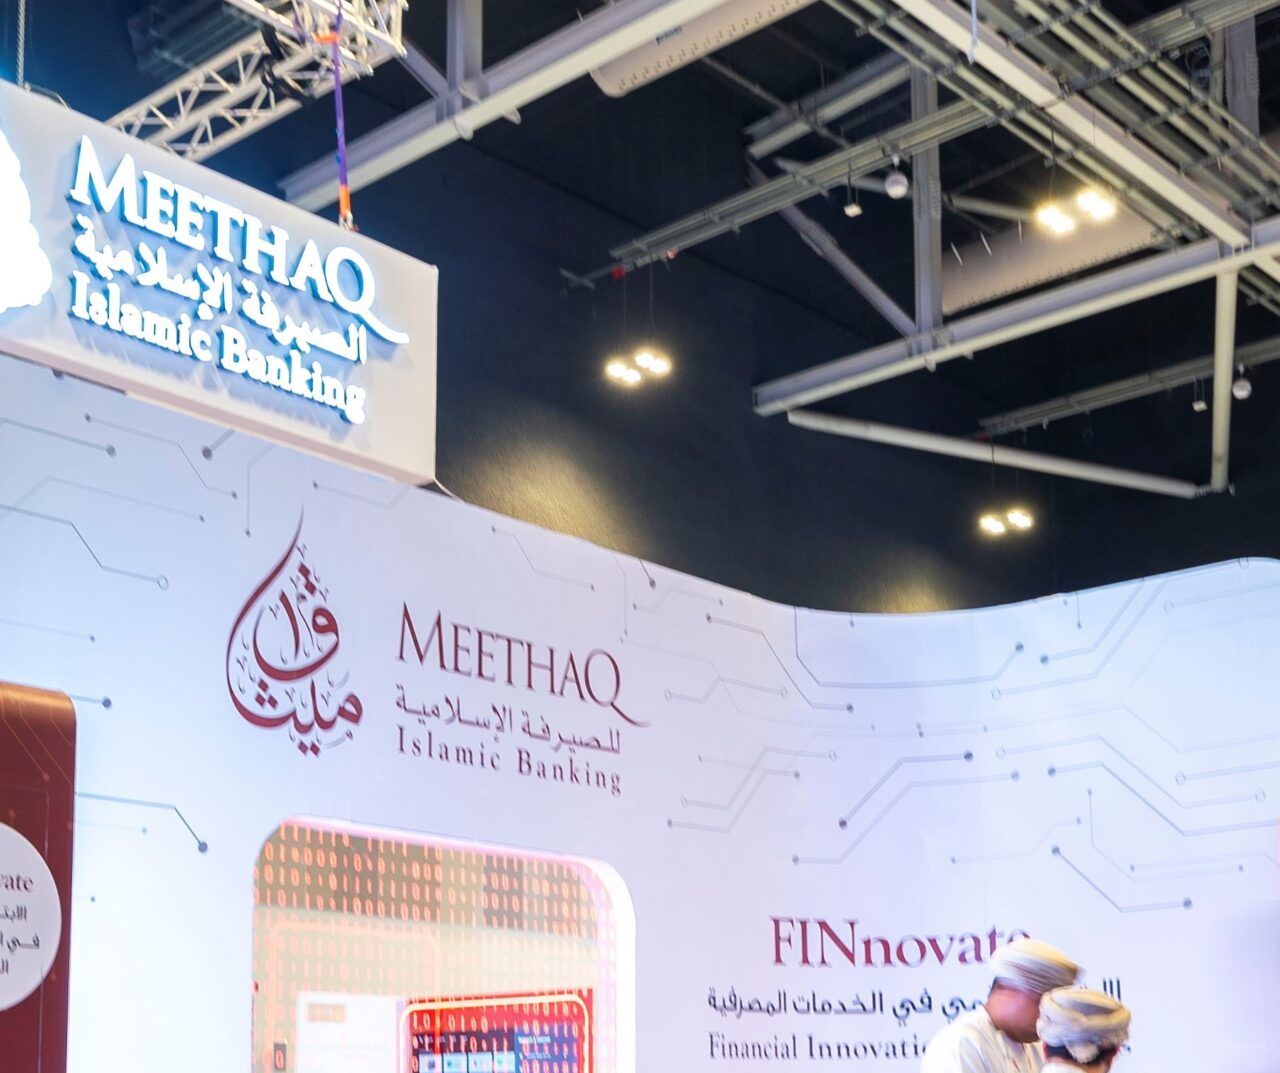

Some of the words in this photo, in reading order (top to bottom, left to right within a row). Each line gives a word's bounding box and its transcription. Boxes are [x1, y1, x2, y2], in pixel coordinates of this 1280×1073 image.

[69, 133, 411, 345] MEETHAQ
[71, 269, 213, 362] Islamic
[219, 324, 368, 425] Banking
[395, 600, 651, 728] MEETHAQ
[396, 723, 503, 772] Islamic
[516, 746, 622, 798] Banking
[708, 1031, 798, 1061] Financial
[807, 1033, 927, 1061] Innovati
